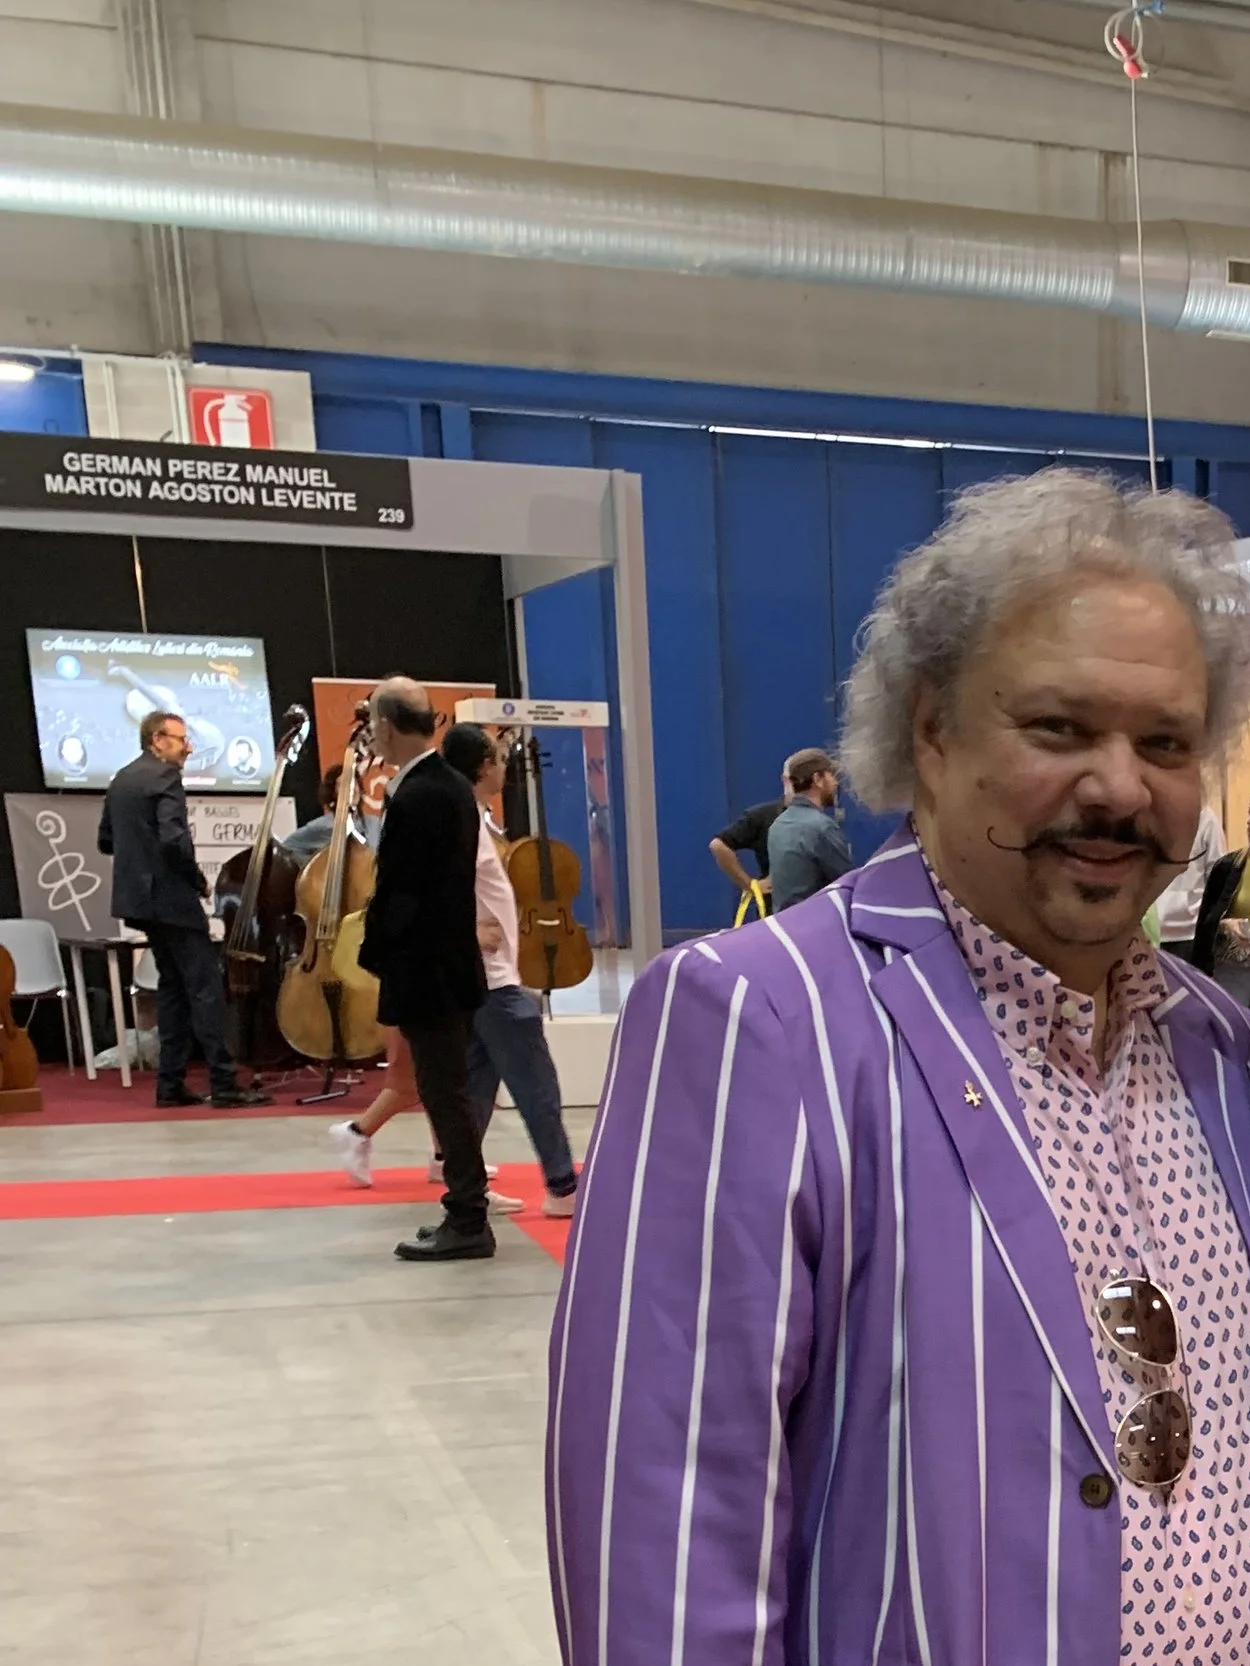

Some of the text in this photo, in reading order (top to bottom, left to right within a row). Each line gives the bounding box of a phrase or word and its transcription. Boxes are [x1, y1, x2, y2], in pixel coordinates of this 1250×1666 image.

[62, 452, 336, 489] GERMAN PEREZ MANUEL
[44, 474, 357, 511] MARTON AGOSTON LEVENTE
[378, 507, 405, 524] 239
